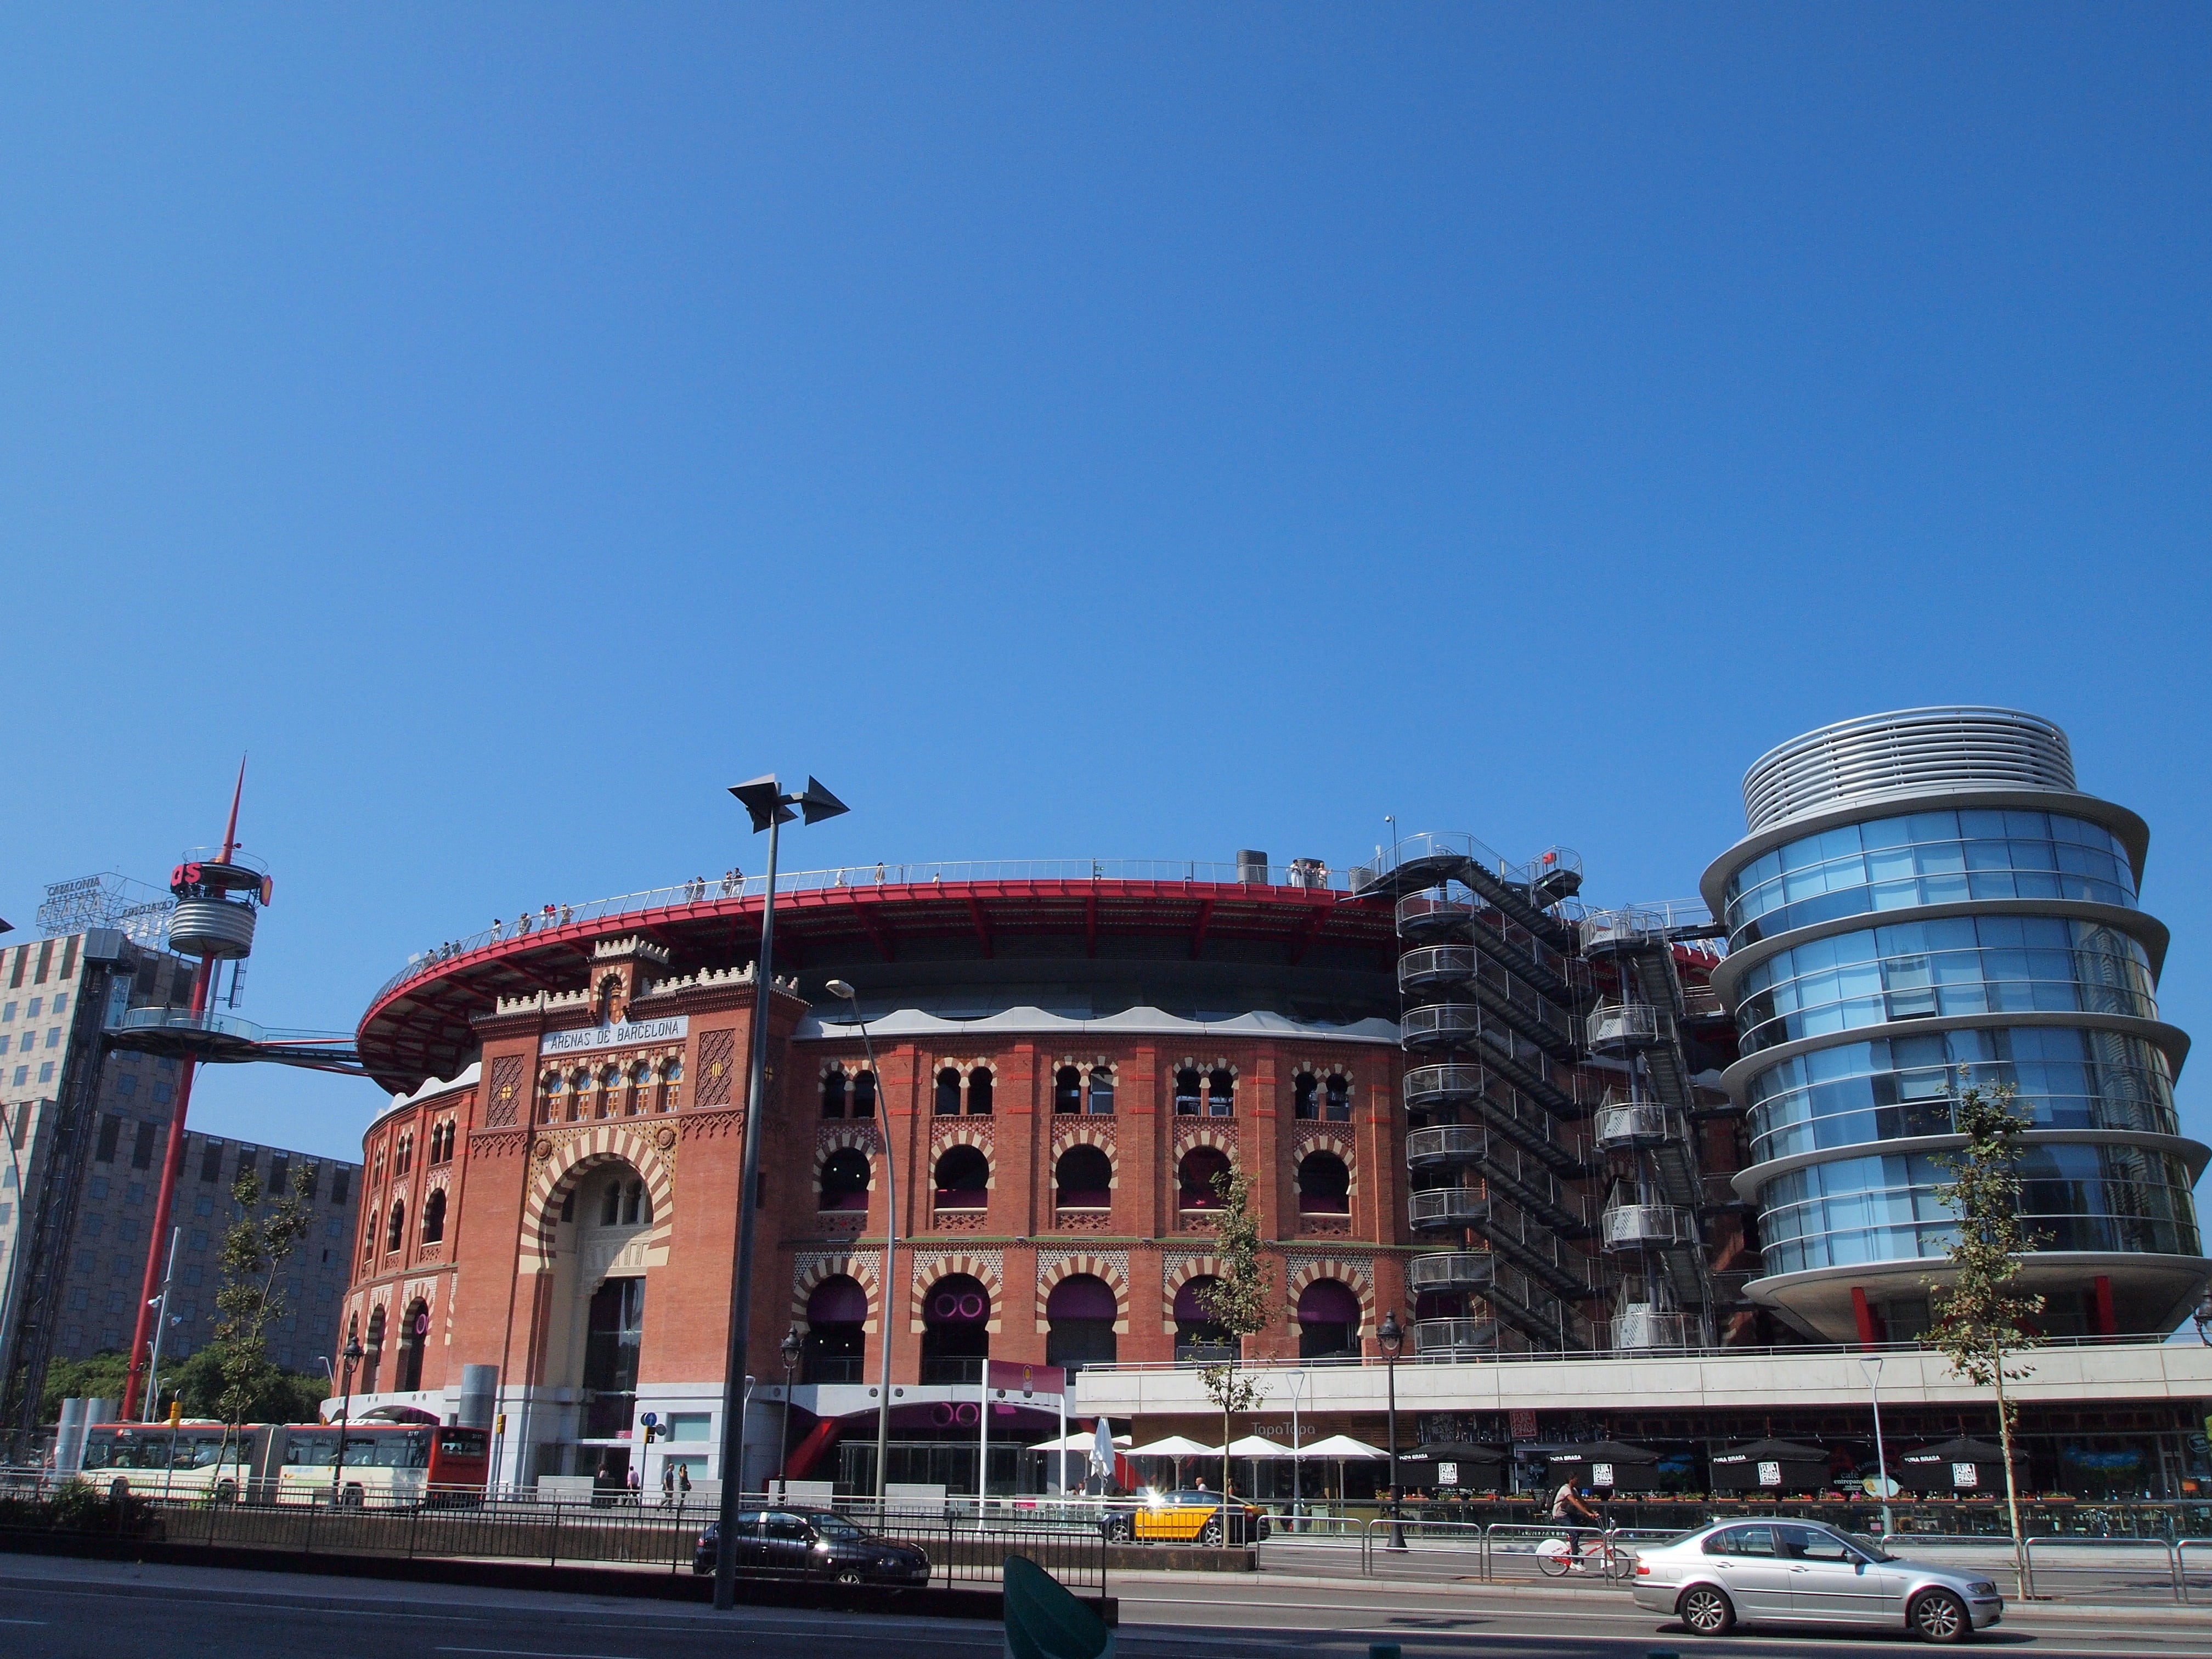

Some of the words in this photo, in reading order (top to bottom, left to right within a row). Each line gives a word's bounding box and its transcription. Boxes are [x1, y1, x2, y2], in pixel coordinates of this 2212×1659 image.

[48, 876, 100, 896] CATALONIA
[37, 894, 101, 923] PLAZA
[551, 1031, 591, 1049] ARENAS
[597, 1029, 611, 1043] DE
[617, 1021, 679, 1041] BARCELONA
